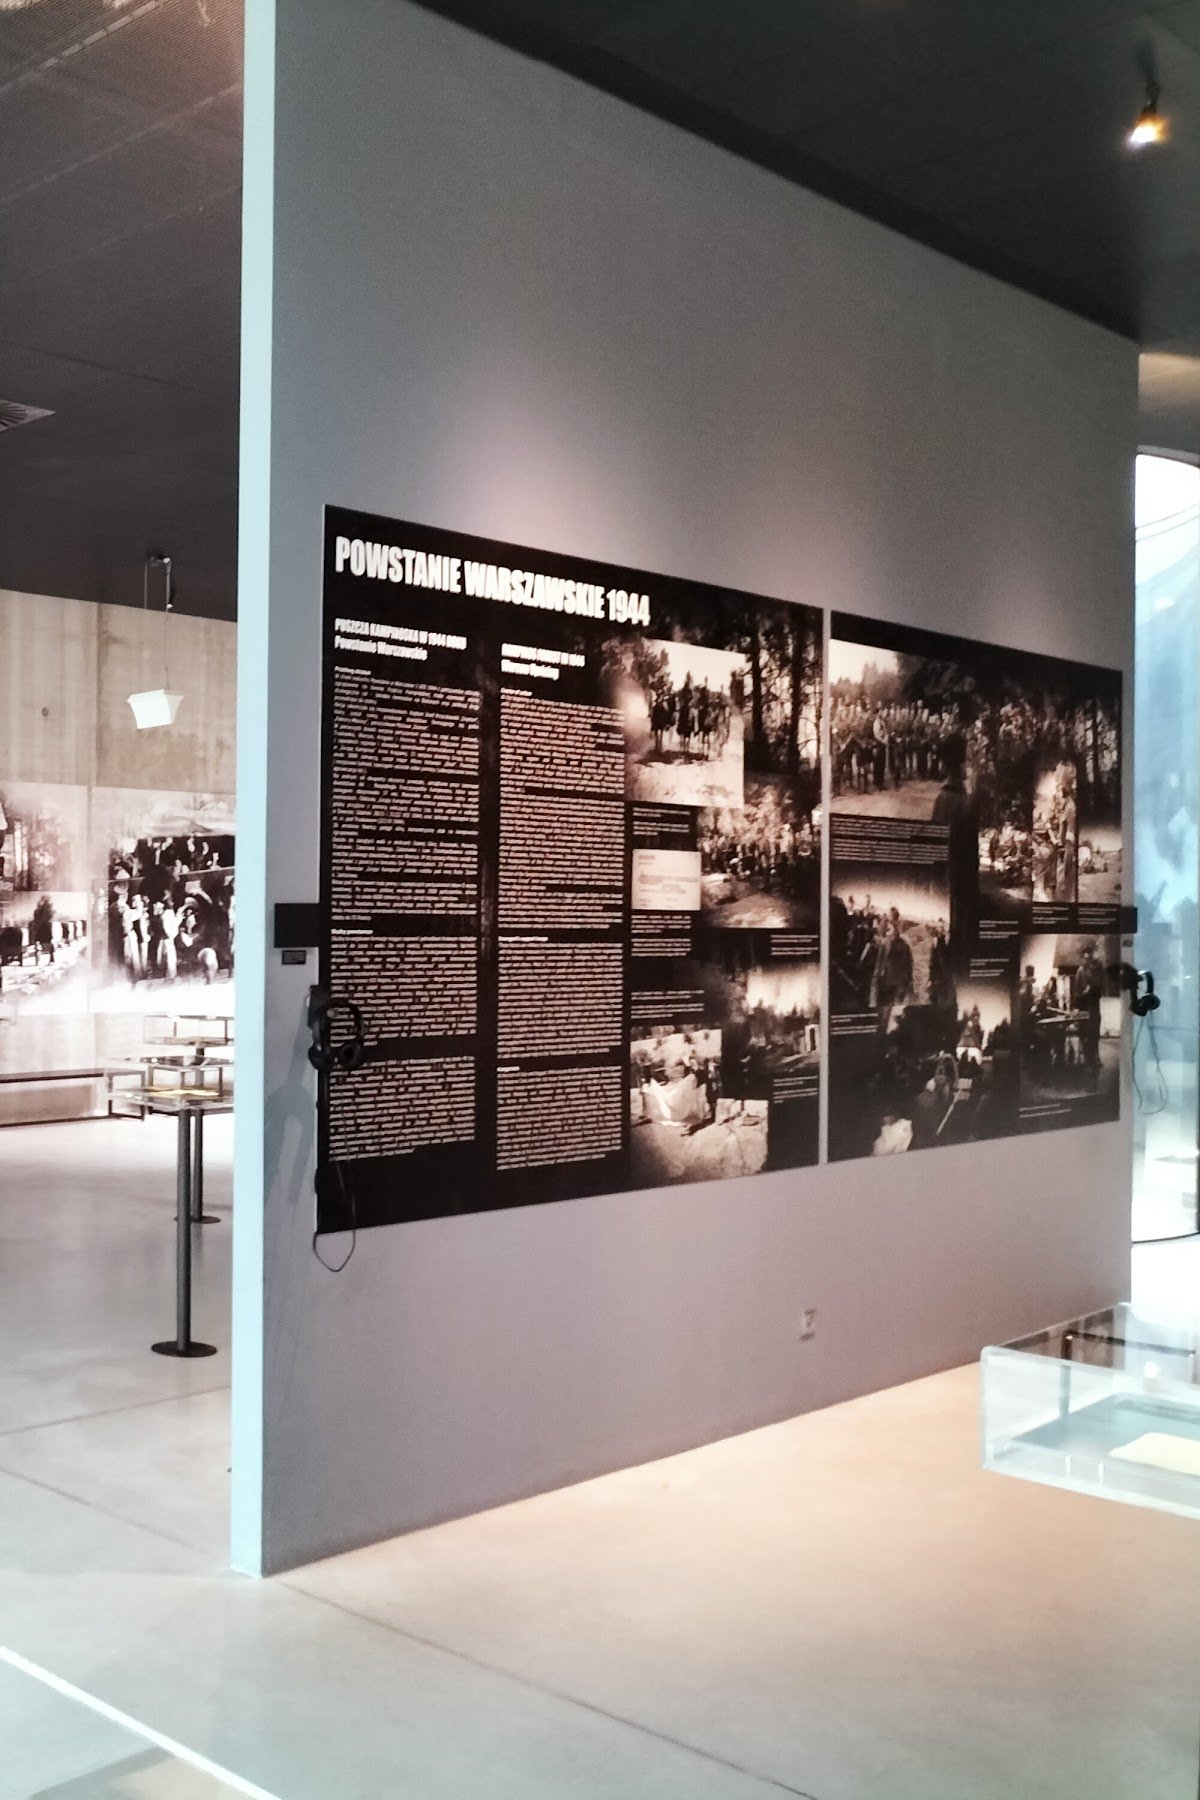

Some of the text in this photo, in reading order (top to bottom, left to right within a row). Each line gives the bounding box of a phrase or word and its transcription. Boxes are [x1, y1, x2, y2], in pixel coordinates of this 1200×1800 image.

[335, 536, 651, 627] POWSTANIE WARSZAWSKIE 1944
